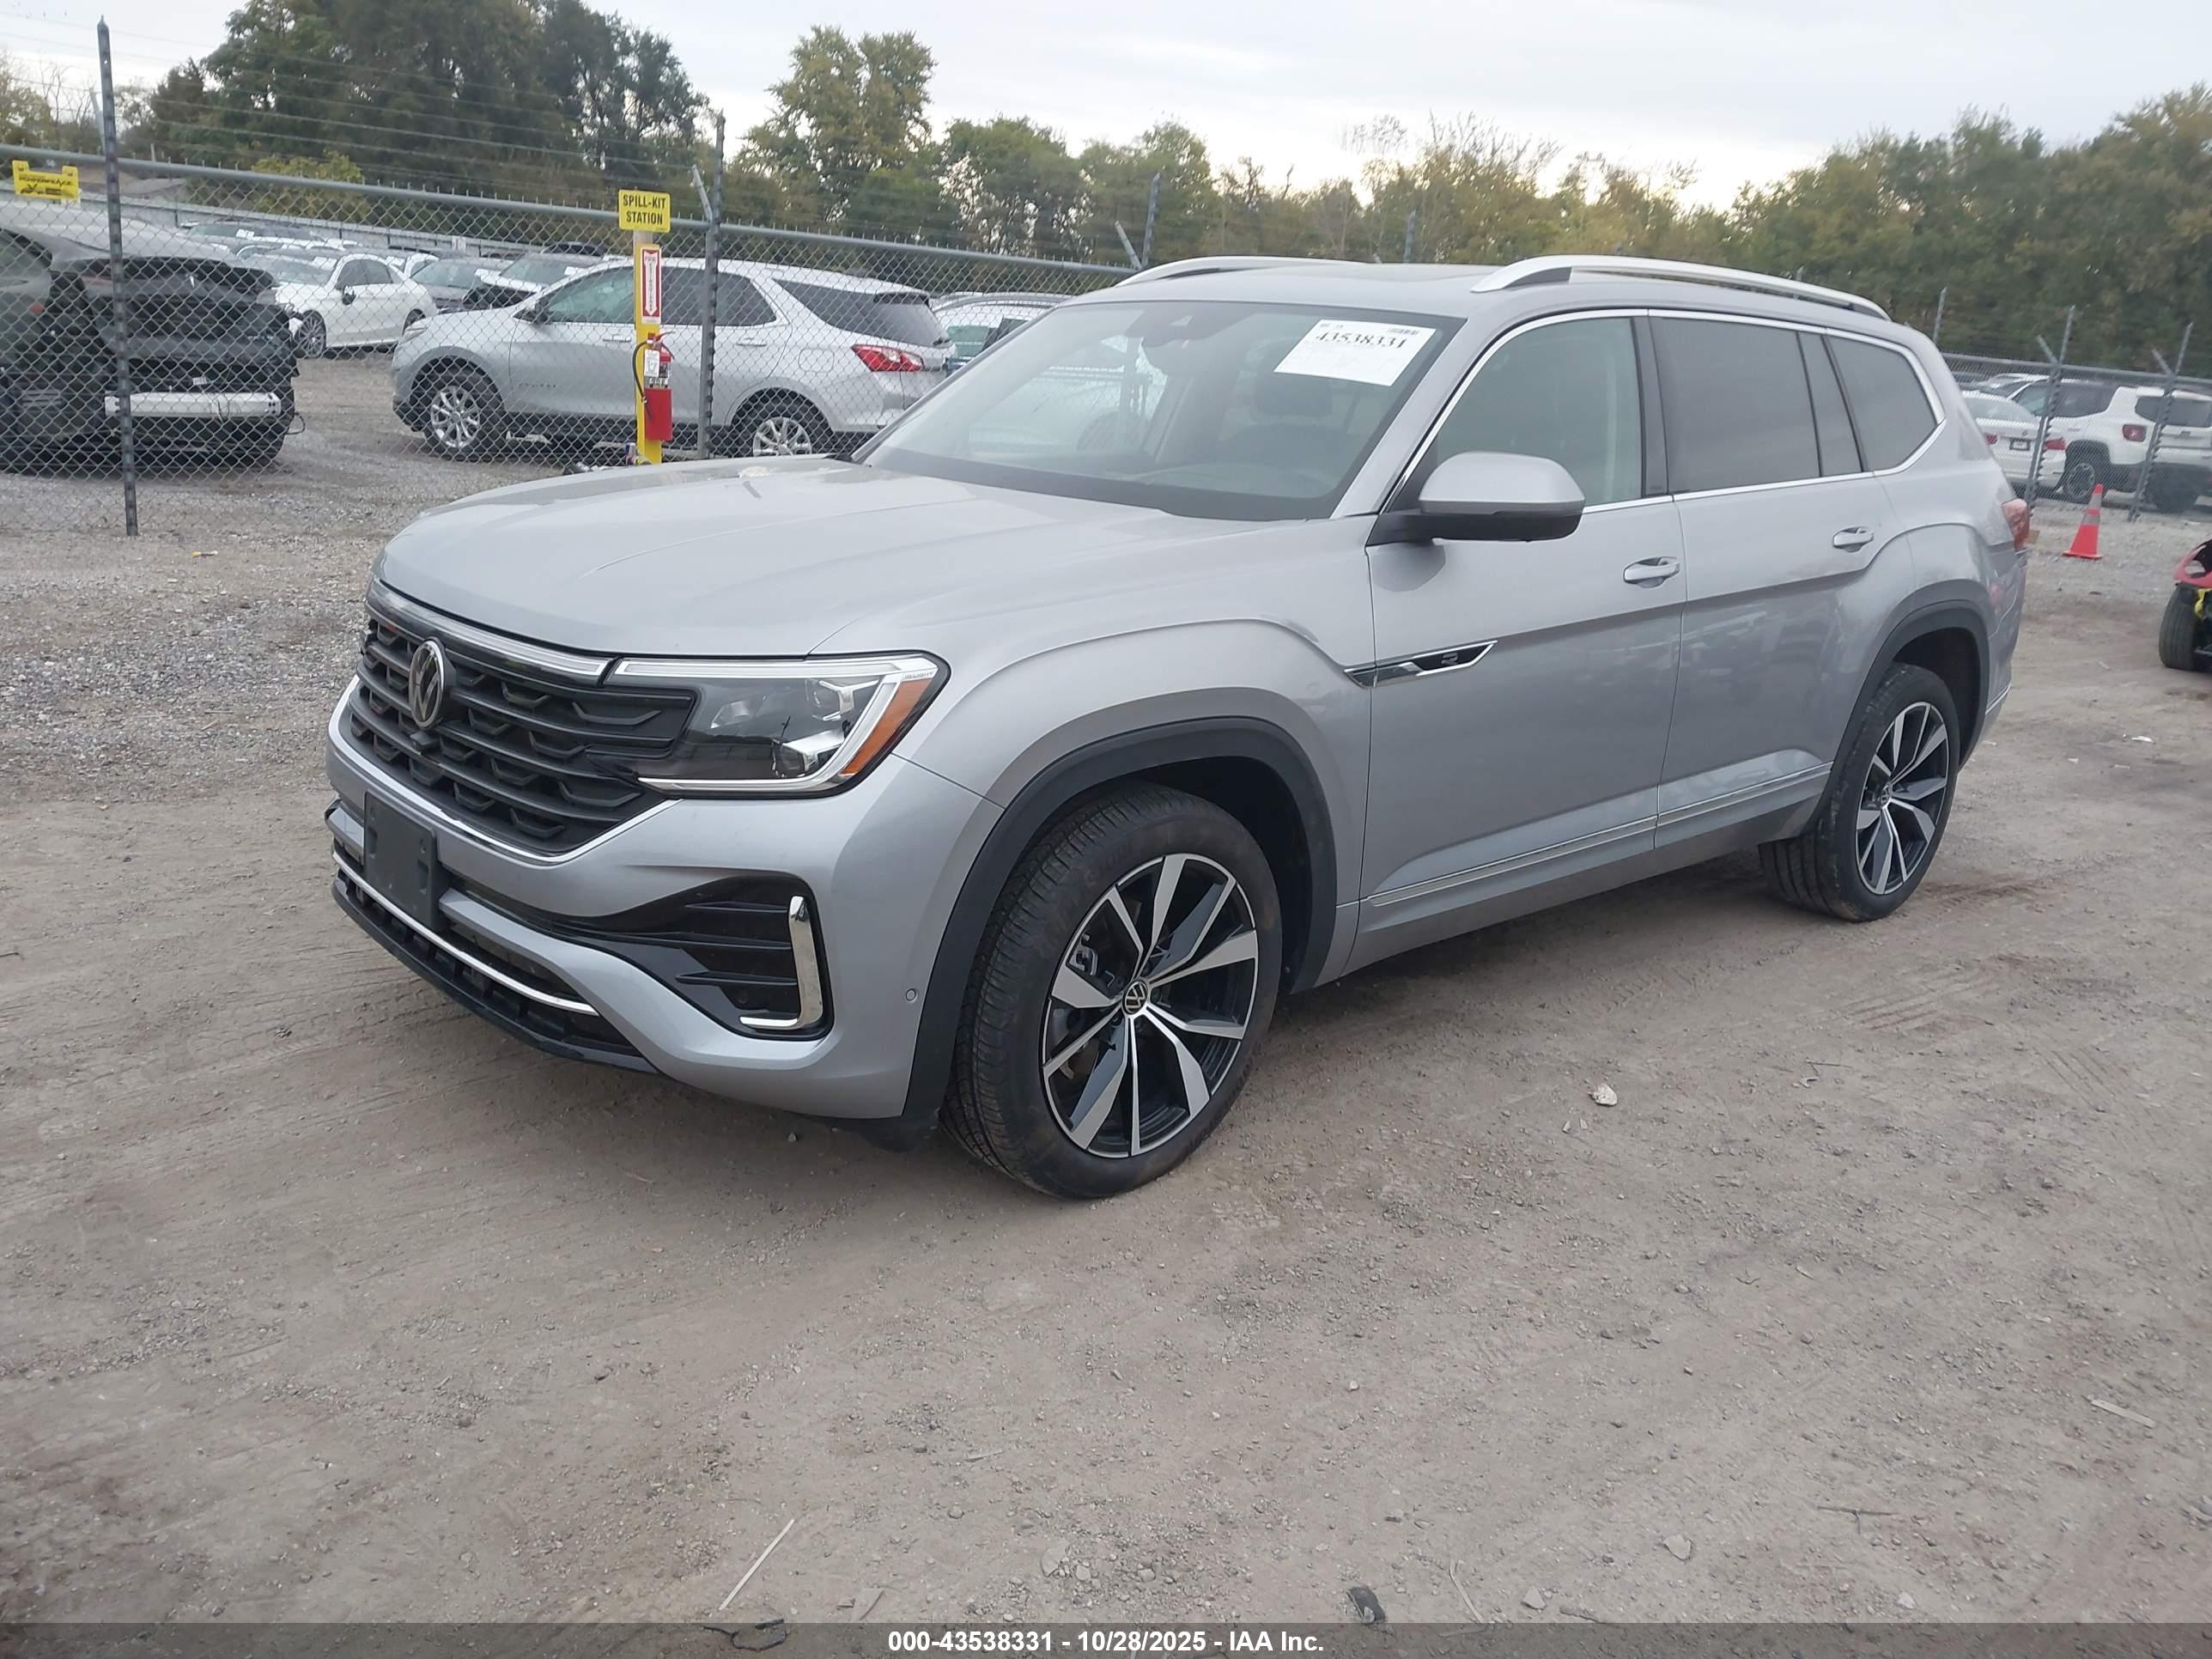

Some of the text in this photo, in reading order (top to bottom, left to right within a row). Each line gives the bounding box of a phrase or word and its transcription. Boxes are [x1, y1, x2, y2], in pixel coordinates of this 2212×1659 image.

[623, 194, 666, 209] SPILL-KIT
[626, 210, 663, 225] STATION
[1315, 331, 1408, 349] 43538331
